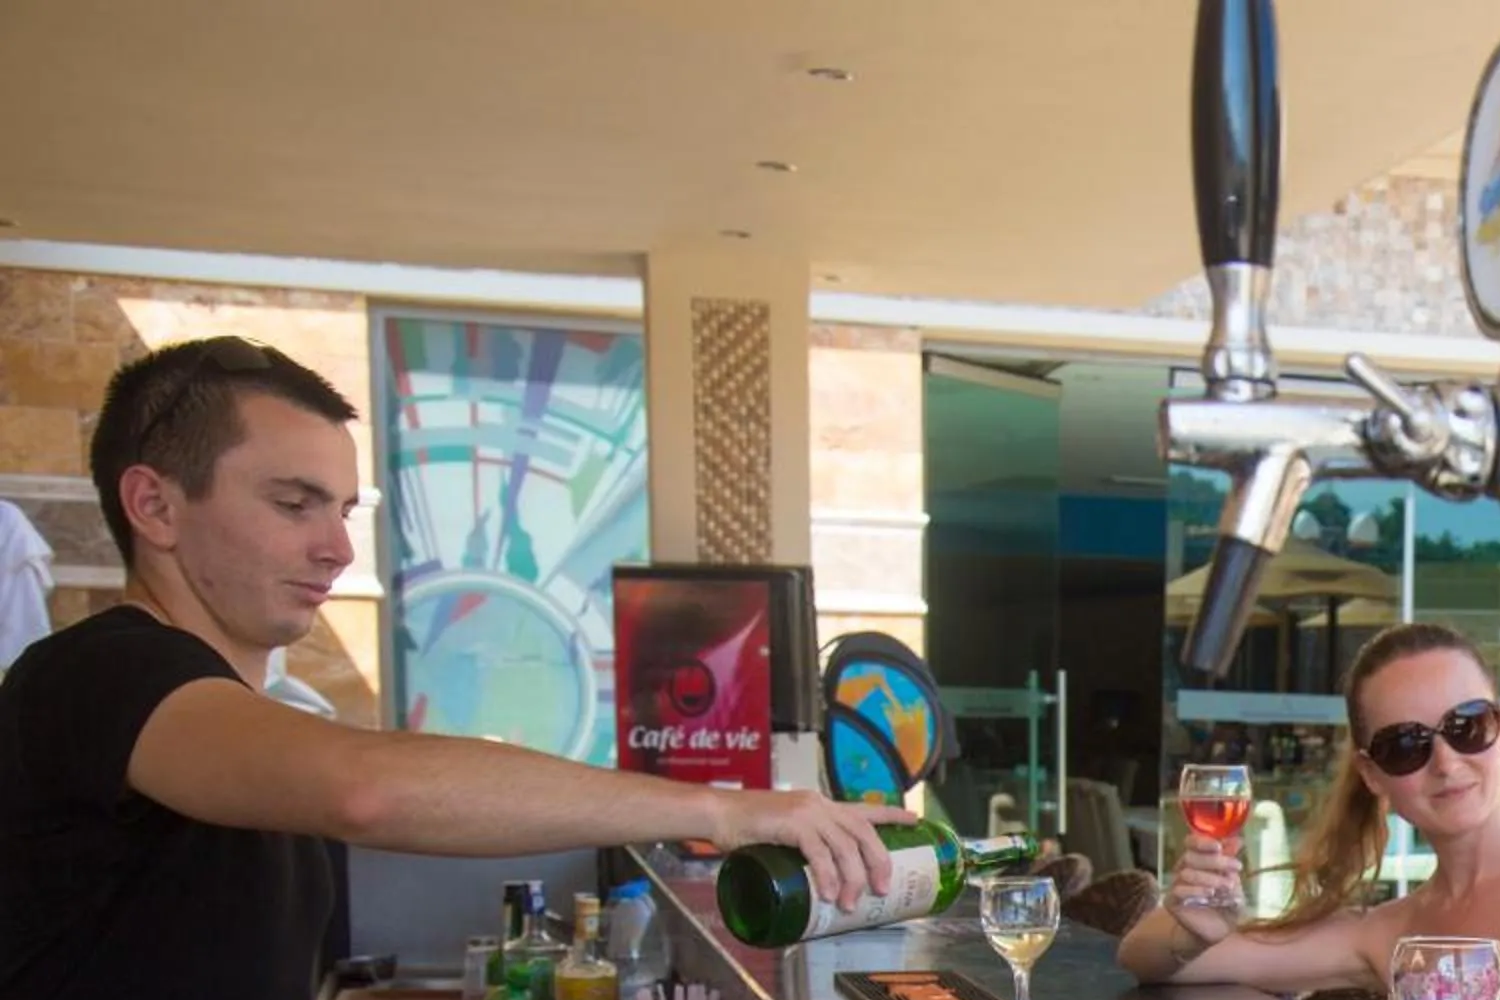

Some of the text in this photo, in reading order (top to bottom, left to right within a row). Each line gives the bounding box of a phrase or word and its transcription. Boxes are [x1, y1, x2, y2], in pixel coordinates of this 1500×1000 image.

[628, 725, 761, 752] Café de vie
